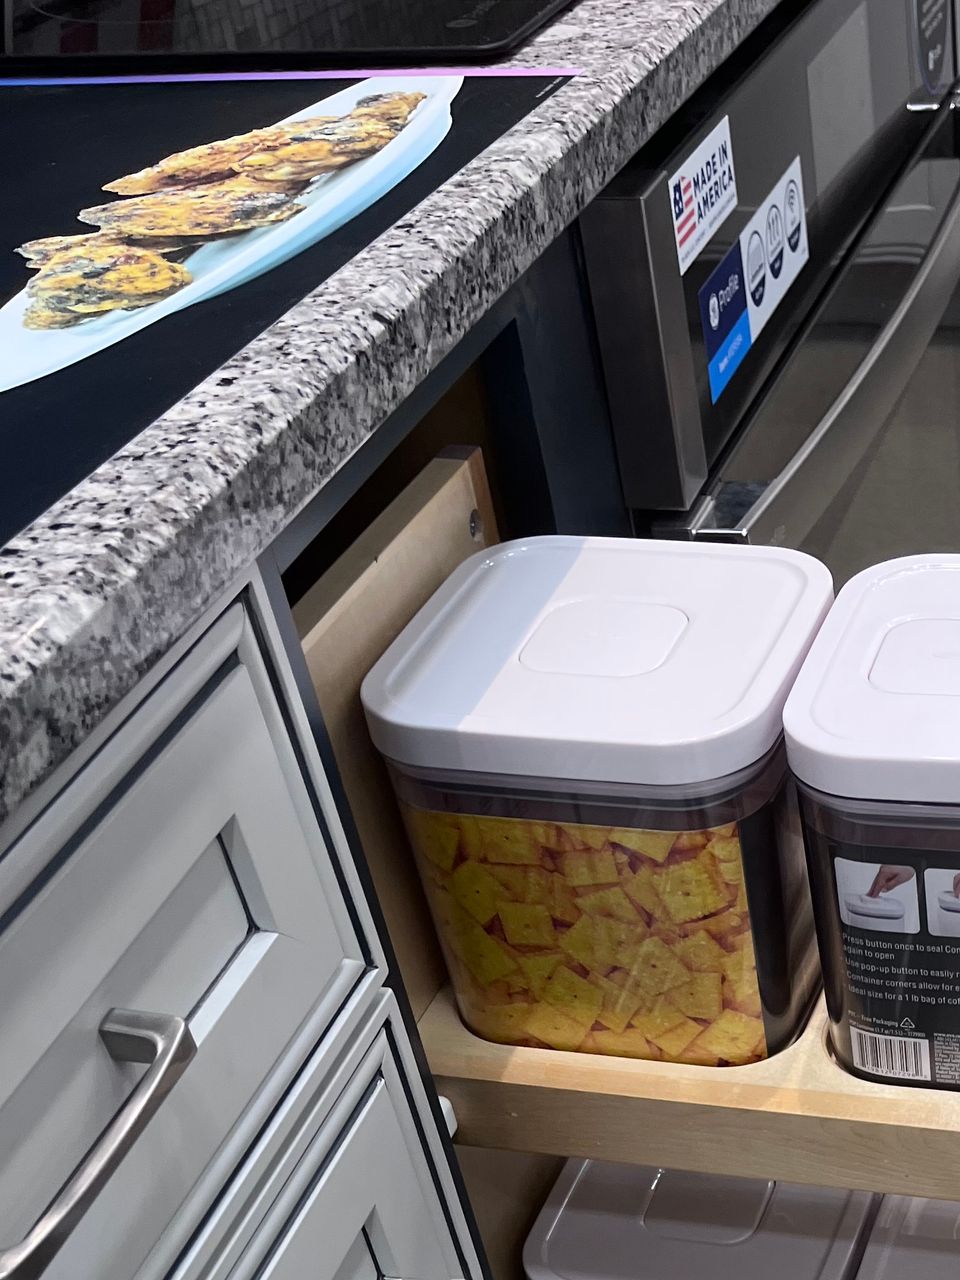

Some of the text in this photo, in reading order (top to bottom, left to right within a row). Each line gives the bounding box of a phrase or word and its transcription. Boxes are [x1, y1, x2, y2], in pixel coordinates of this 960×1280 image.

[693, 140, 728, 199] MADE IN
[697, 165, 733, 224] AMERICA
[718, 273, 740, 313] Profile
[843, 933, 864, 946] Press
[865, 939, 893, 950] button
[916, 944, 925, 952] to
[926, 945, 943, 953] seal
[844, 944, 895, 960] again to open
[845, 957, 860, 968] Use
[861, 962, 891, 975] pop-up
[891, 966, 919, 976] button
[930, 969, 954, 980] easily
[846, 970, 884, 986] Container
[885, 980, 917, 989] corners
[918, 981, 941, 991] allow
[941, 982, 954, 991] for
[848, 983, 866, 995] Ideal
[867, 989, 884, 999] size
[884, 992, 897, 1000] for
[911, 994, 920, 1002] lb
[920, 996, 936, 1005] bag
